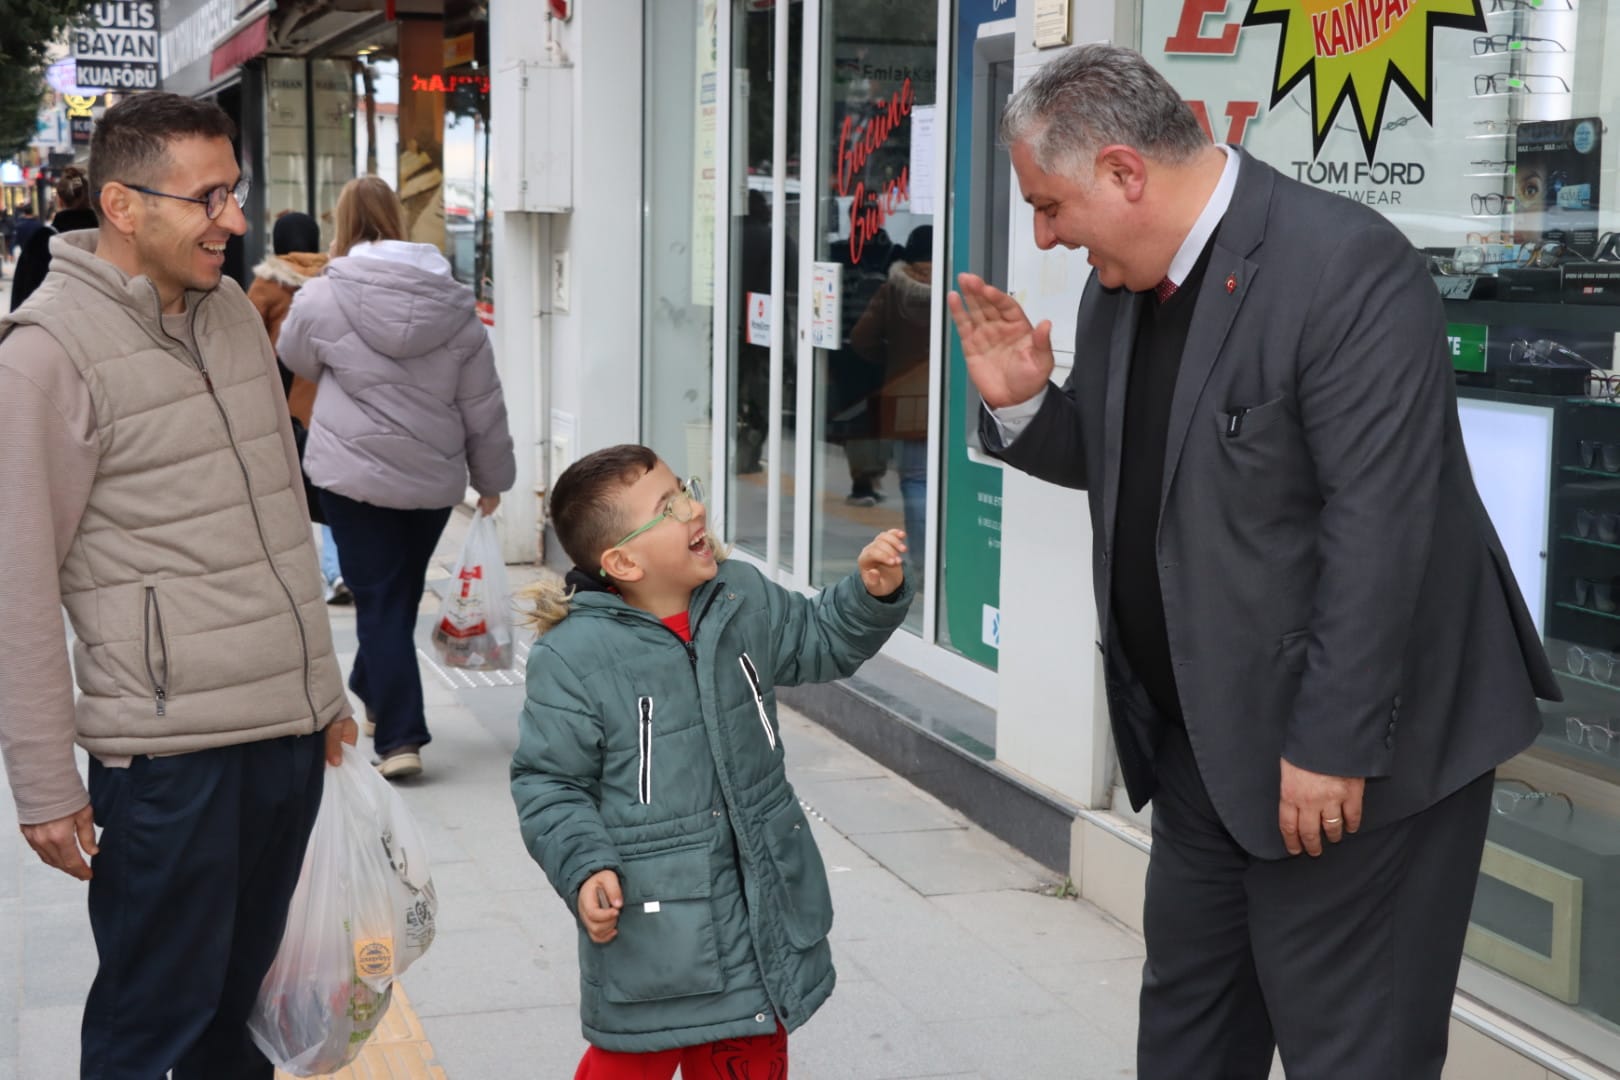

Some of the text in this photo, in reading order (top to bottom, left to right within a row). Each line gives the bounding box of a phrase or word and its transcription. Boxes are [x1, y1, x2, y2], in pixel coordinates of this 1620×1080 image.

[77, 32, 154, 57] BAYAN
[77, 63, 157, 88] KUAFÖRÜ
[1291, 161, 1425, 185] TOM FORD
